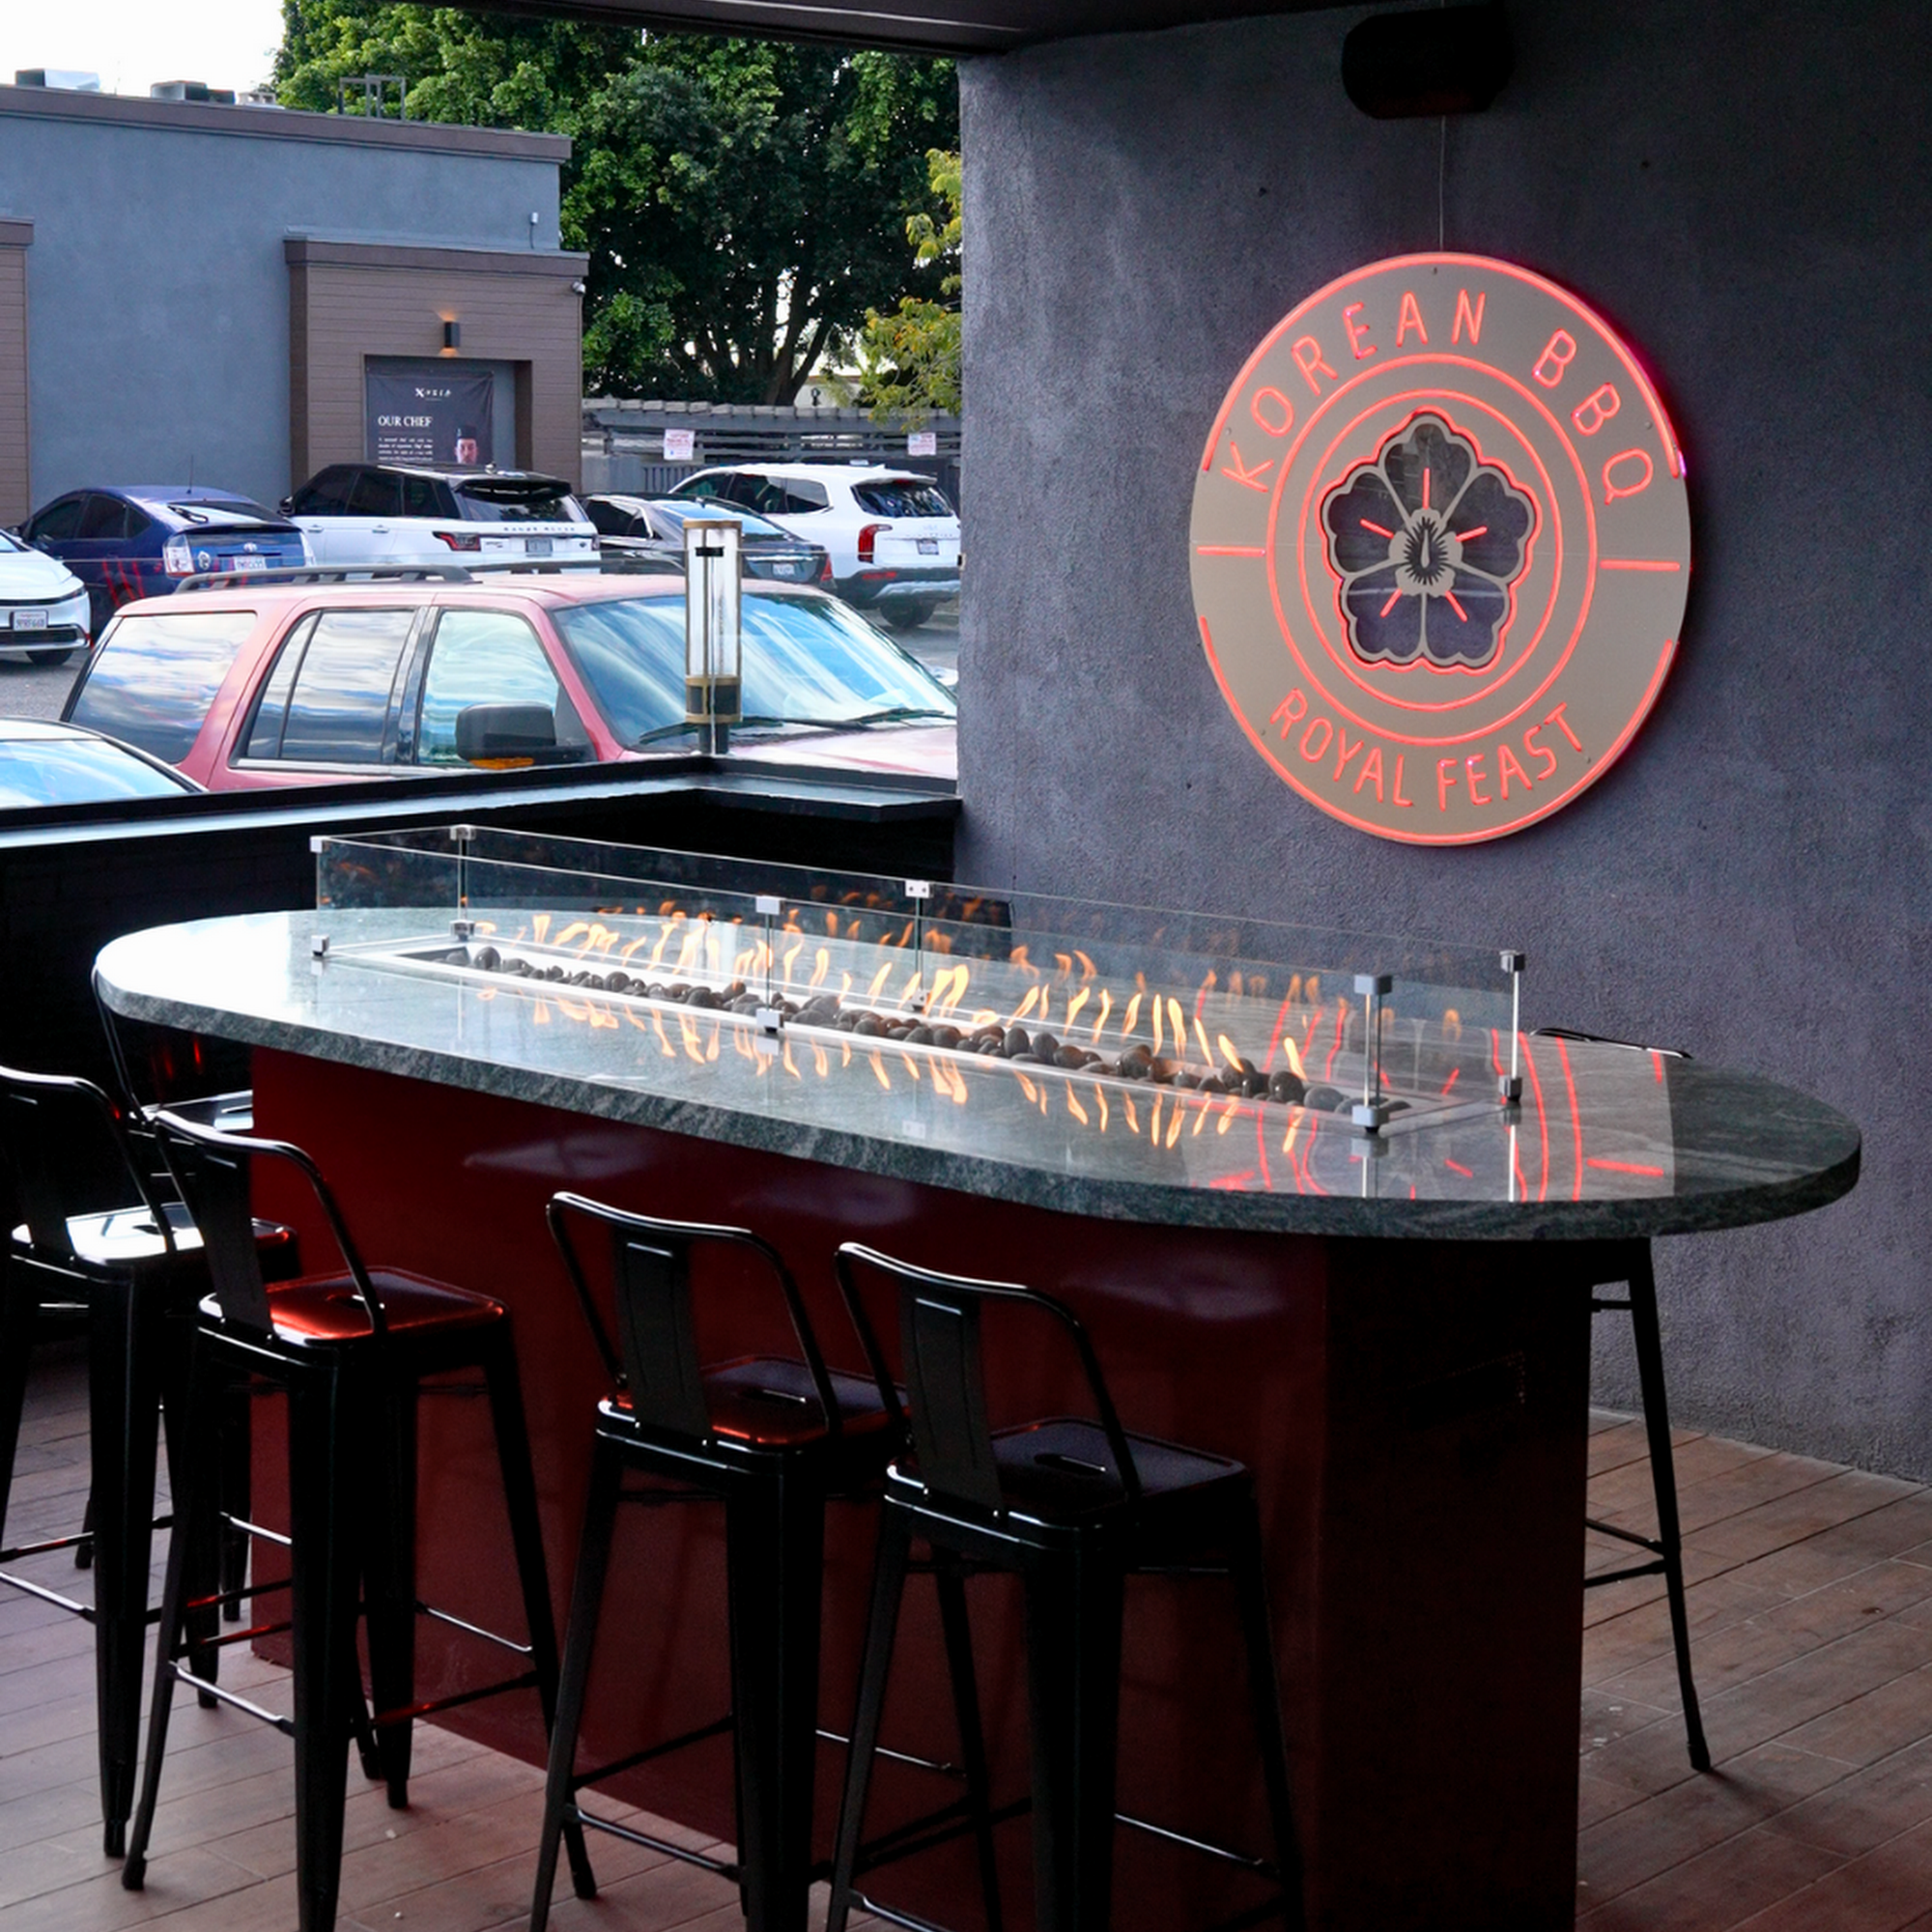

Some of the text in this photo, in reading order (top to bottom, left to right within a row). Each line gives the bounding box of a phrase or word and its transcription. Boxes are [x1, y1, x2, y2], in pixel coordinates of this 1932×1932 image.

[378, 415, 433, 427] OUR CHEF
[1221, 290, 1655, 505] KOREAN BBQ
[1269, 688, 1582, 811] ROYAL FEAST
